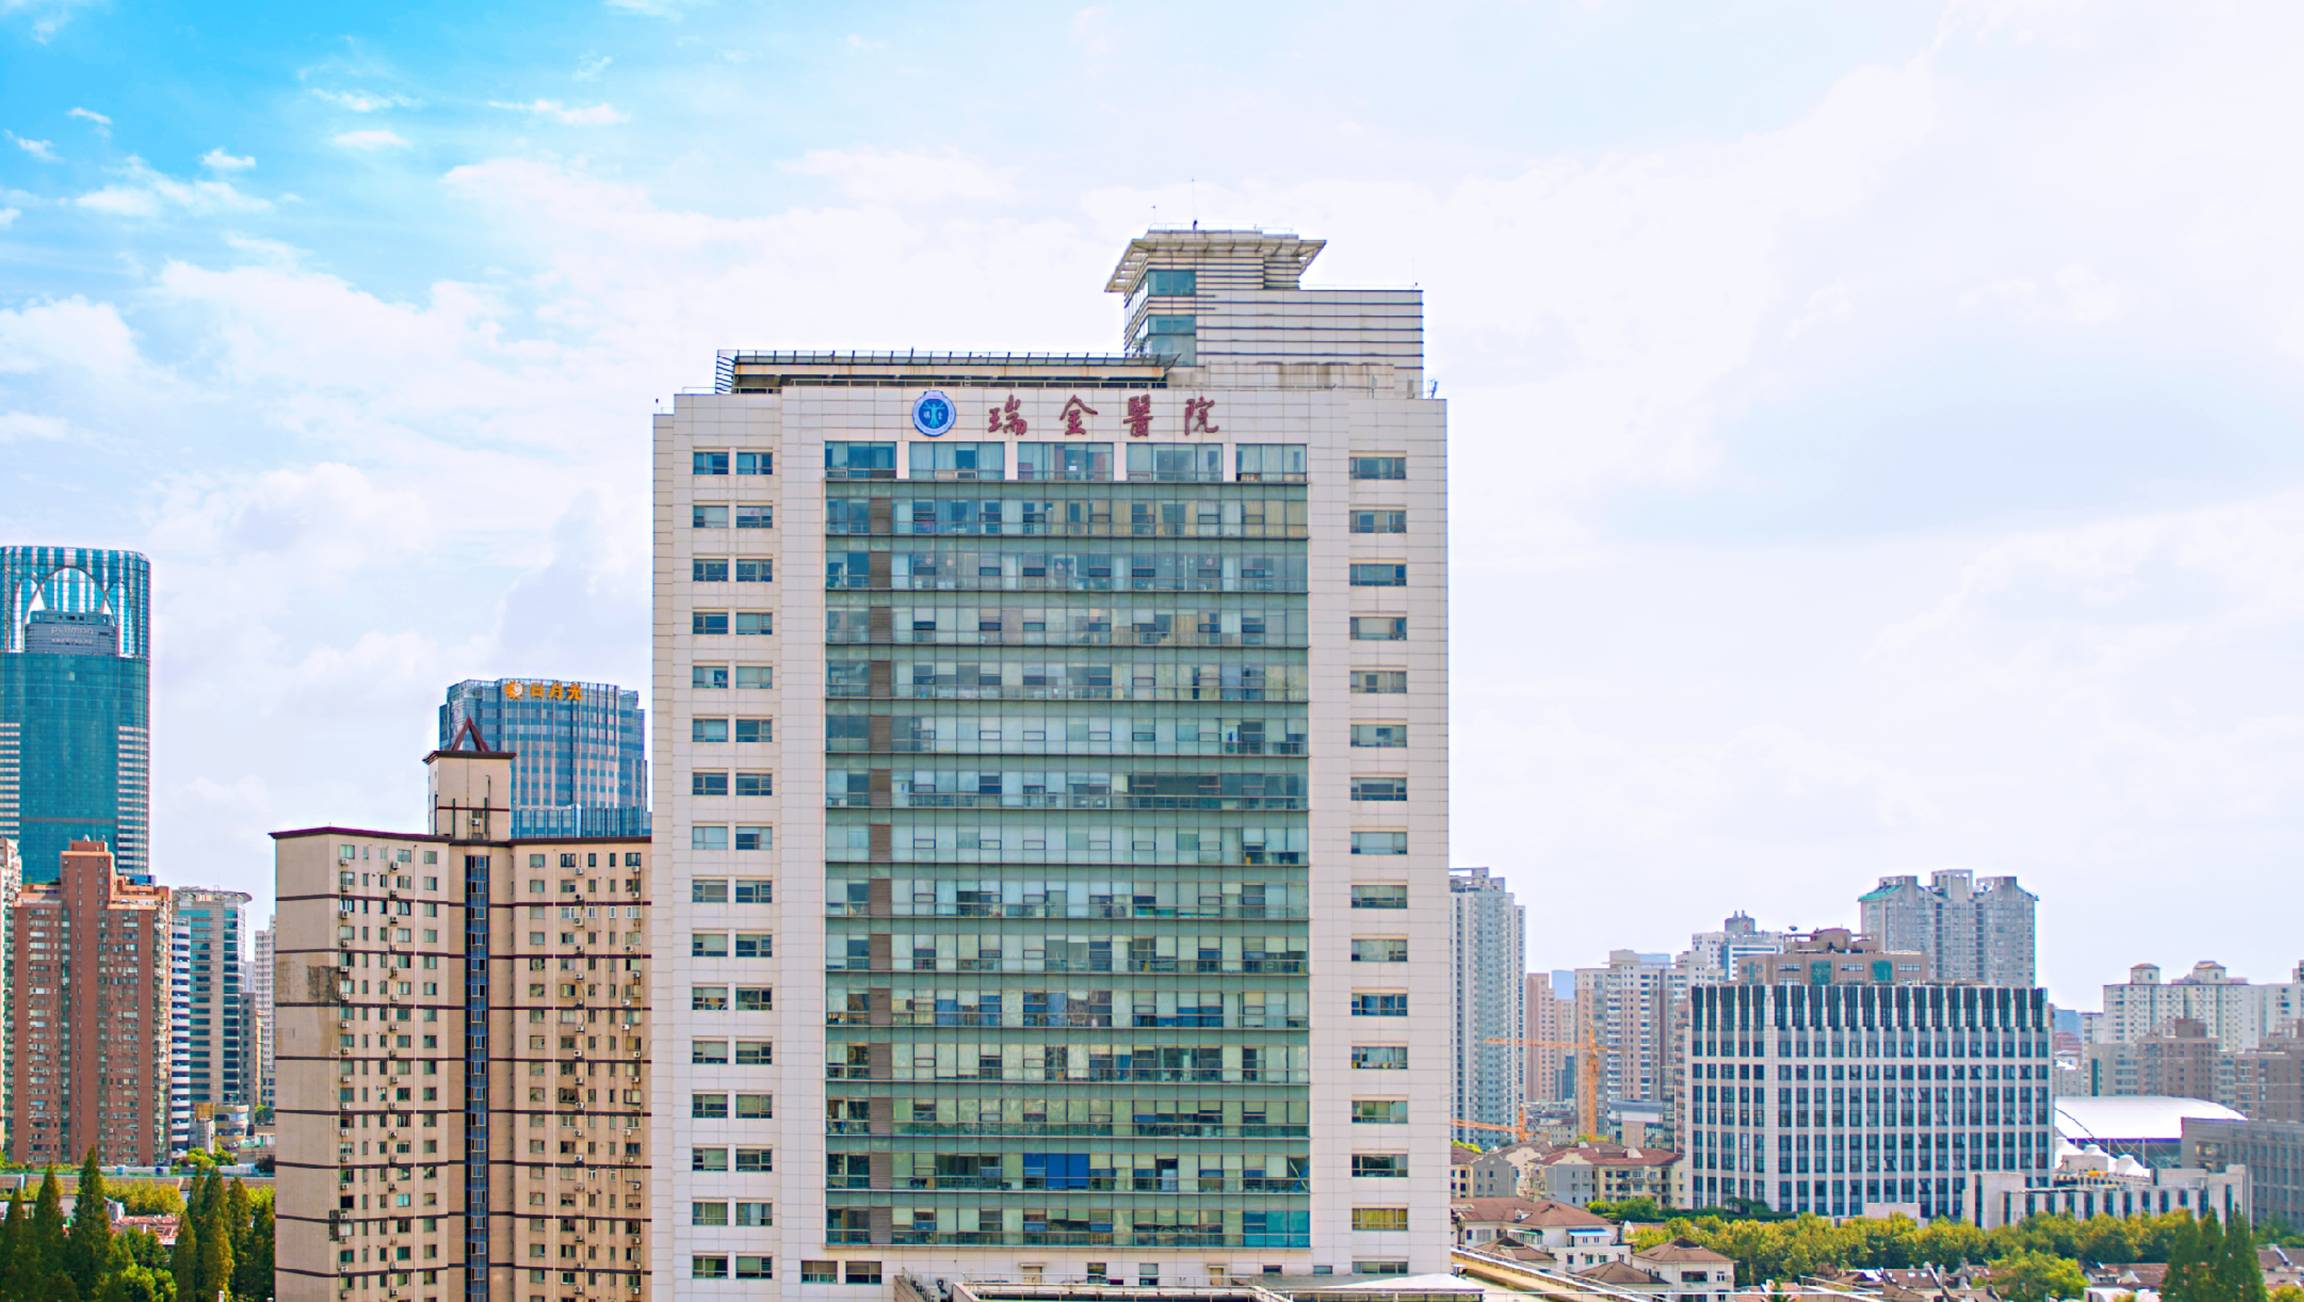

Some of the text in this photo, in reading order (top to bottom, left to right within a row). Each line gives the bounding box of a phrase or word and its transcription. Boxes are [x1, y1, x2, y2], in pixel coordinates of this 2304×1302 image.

[987, 394, 1219, 436] 瑞金醫院
[530, 680, 582, 700] 日月光
